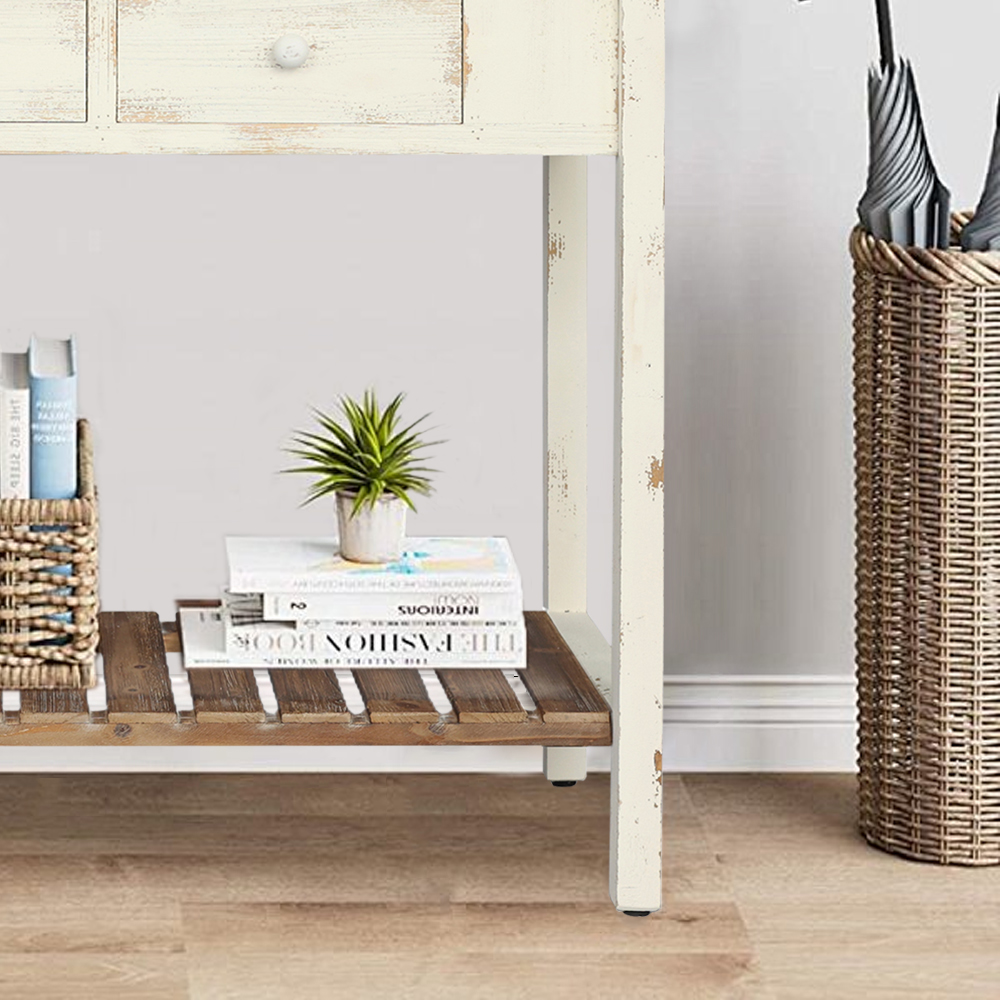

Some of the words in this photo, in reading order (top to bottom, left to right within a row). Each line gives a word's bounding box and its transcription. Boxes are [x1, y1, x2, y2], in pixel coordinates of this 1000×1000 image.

[398, 605, 479, 616] INTERIORS
[325, 633, 453, 652] FASHION
[460, 633, 522, 652] THE
